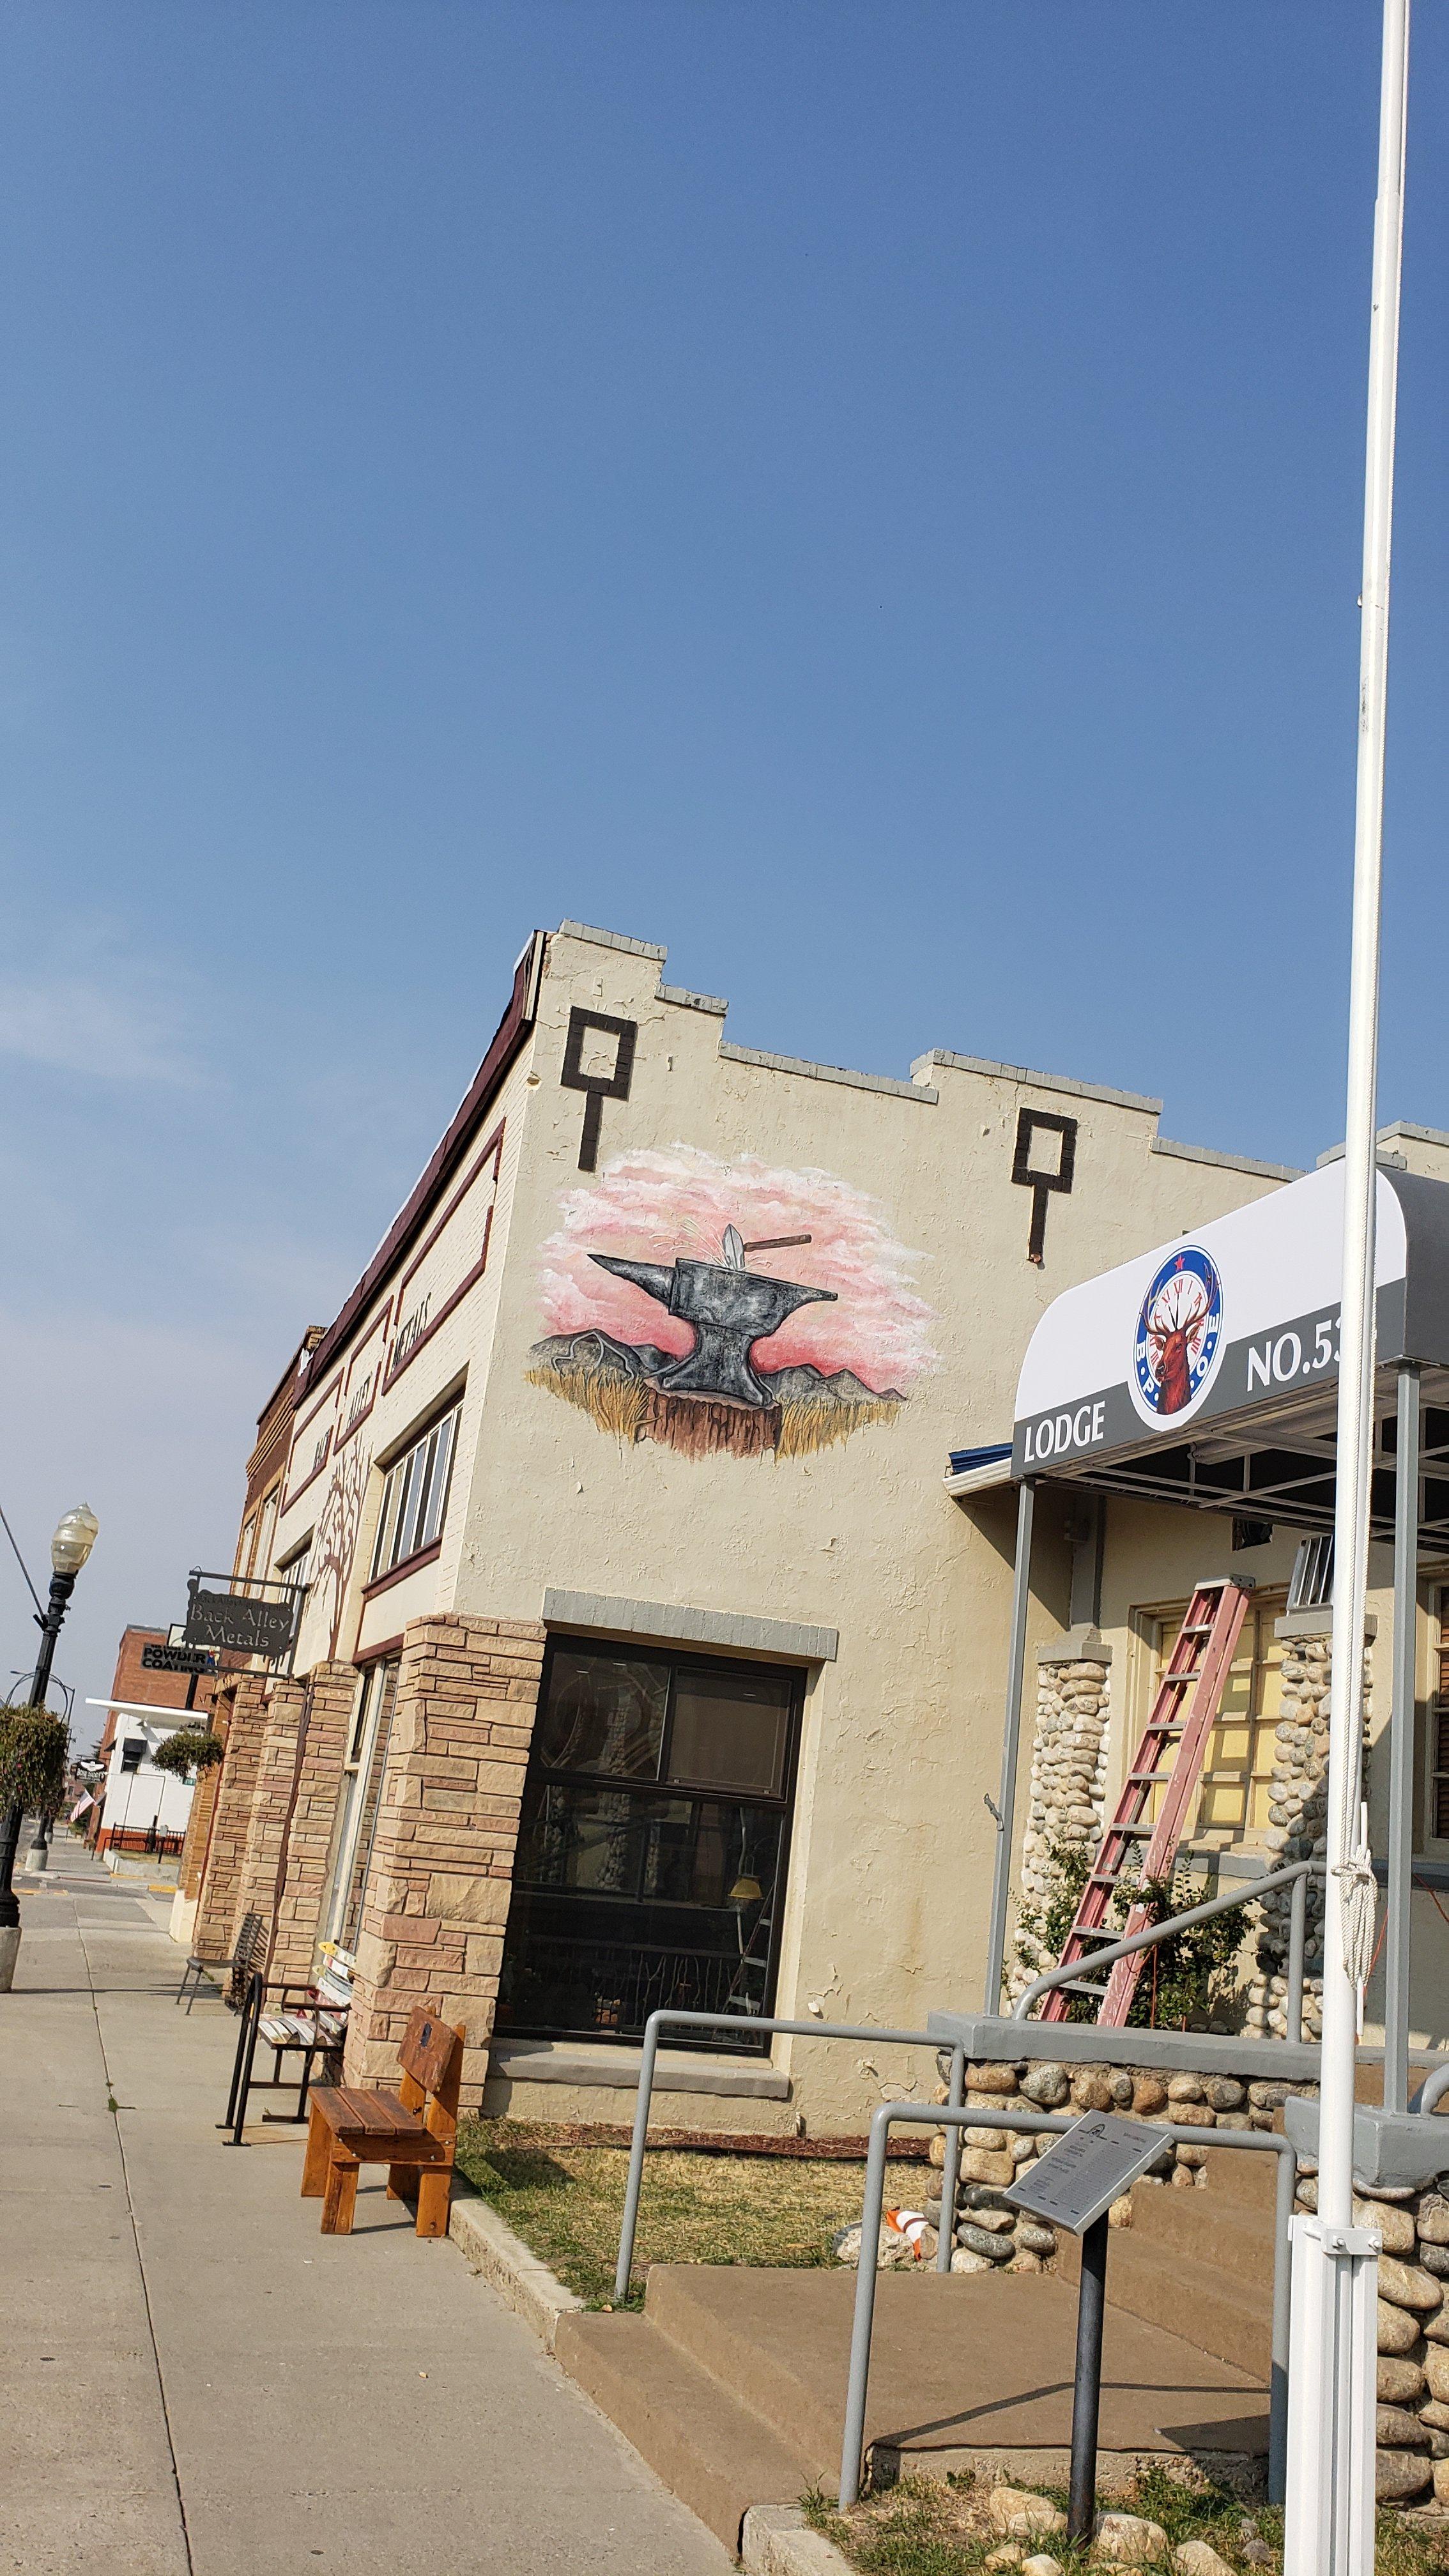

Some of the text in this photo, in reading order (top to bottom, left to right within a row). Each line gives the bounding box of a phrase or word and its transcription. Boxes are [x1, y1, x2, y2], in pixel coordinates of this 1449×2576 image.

[1023, 1316, 1341, 1463] LODGE NO.5
[191, 1602, 234, 1625] Back
[242, 1607, 289, 1632] Alley
[204, 1624, 270, 1648] Metals
